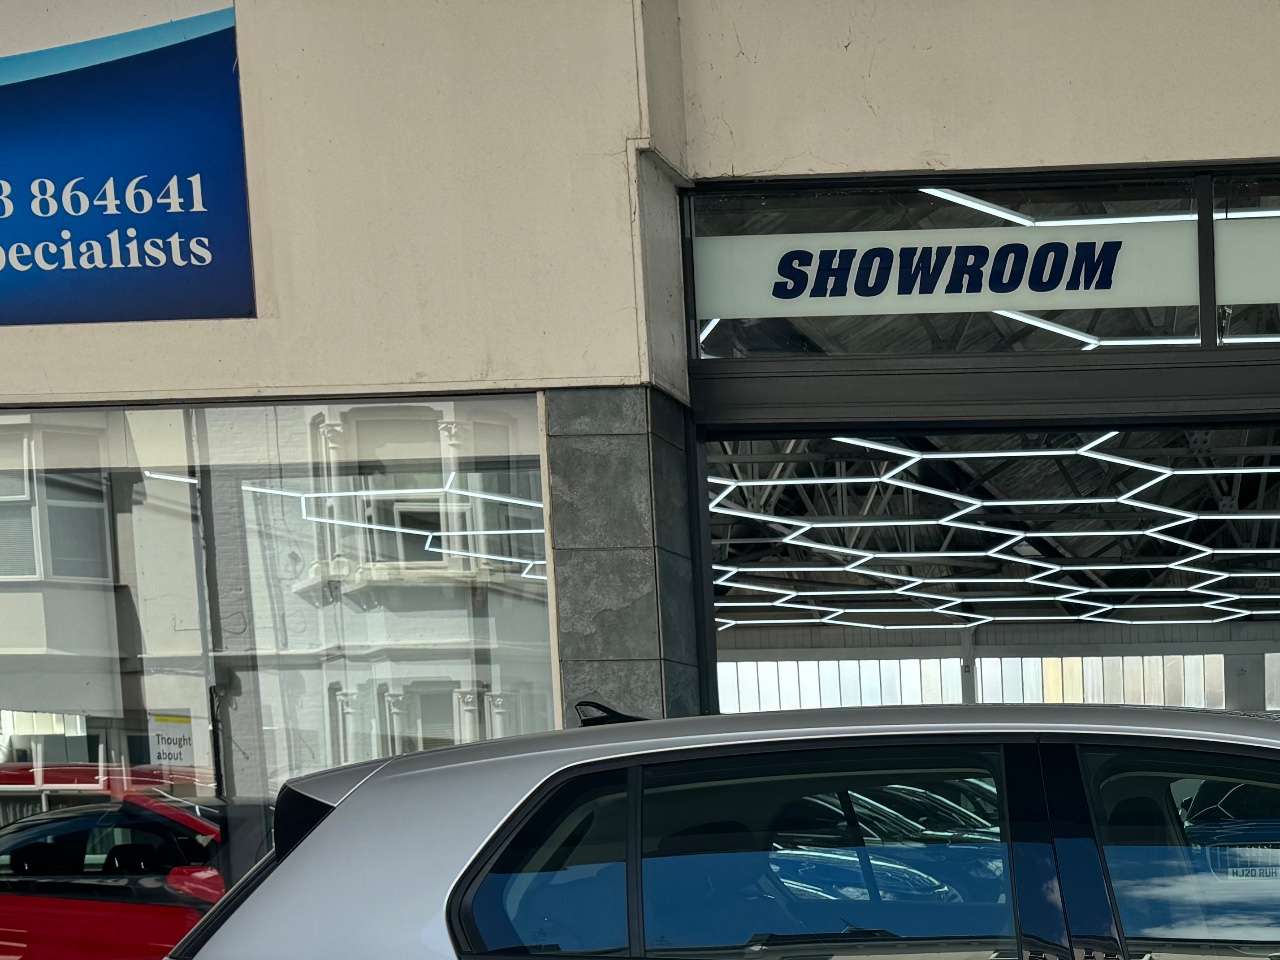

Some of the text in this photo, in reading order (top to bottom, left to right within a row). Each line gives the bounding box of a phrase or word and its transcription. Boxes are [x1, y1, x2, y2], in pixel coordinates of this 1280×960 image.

[30, 172, 208, 217] 864641
[0, 227, 213, 272] ecialists
[771, 240, 1123, 300] SHOWROOM
[155, 733, 193, 749] Thought
[156, 749, 183, 761] about
